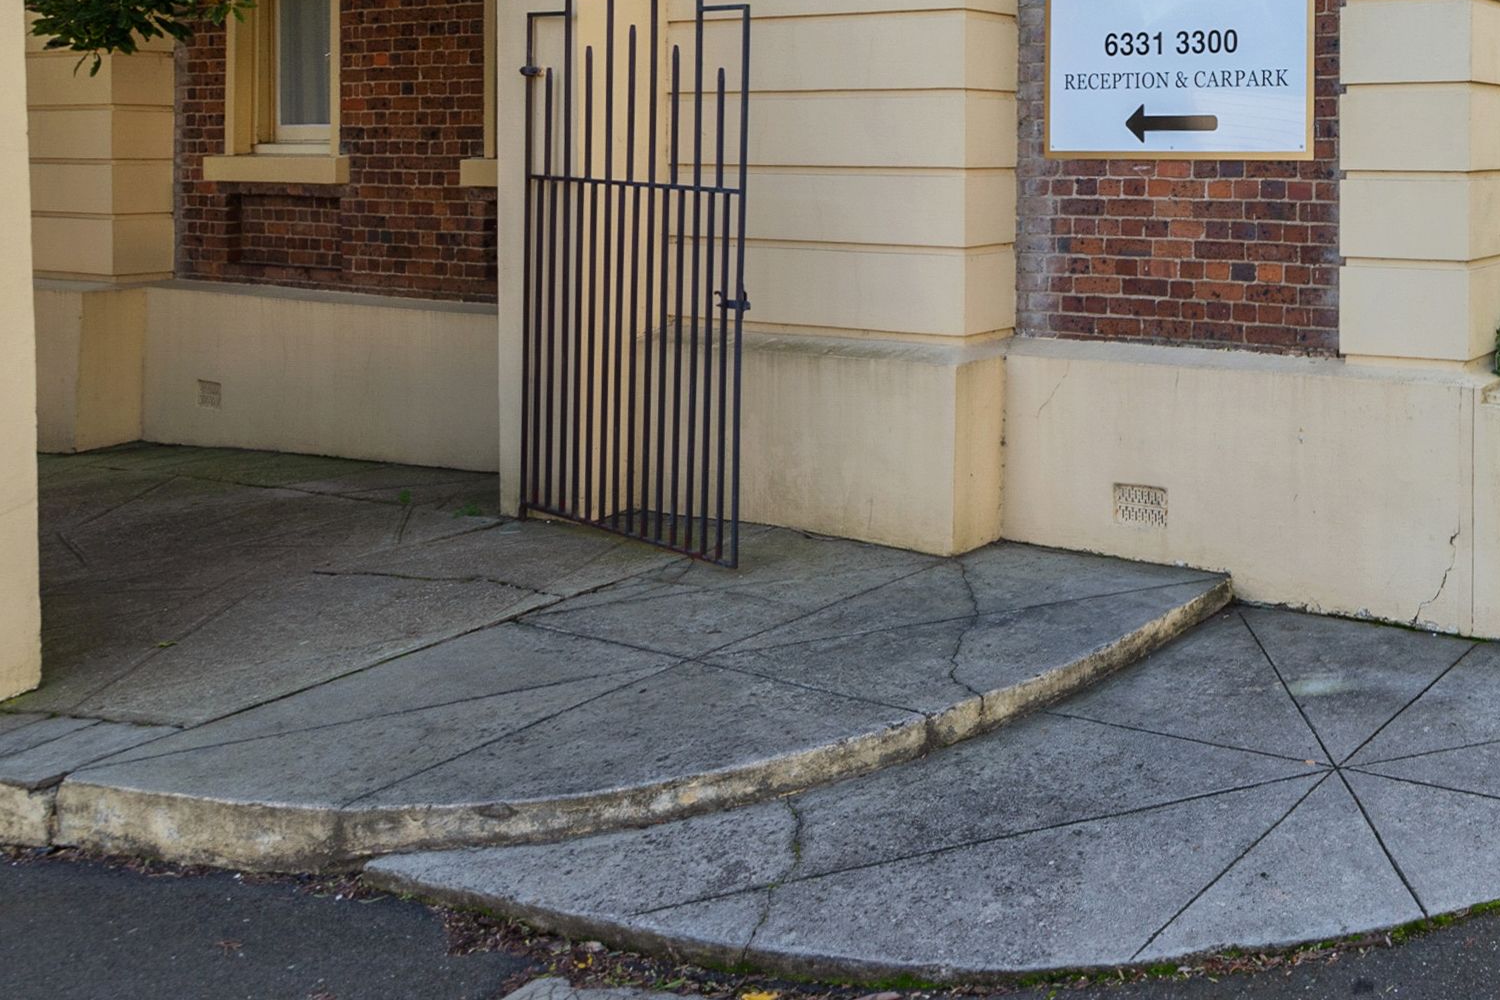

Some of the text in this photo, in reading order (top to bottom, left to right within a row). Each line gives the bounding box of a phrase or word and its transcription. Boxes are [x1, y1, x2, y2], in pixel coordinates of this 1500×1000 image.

[1104, 29, 1238, 57] 6331 3300
[1064, 68, 1289, 90] RECEPTION & CARPARK
